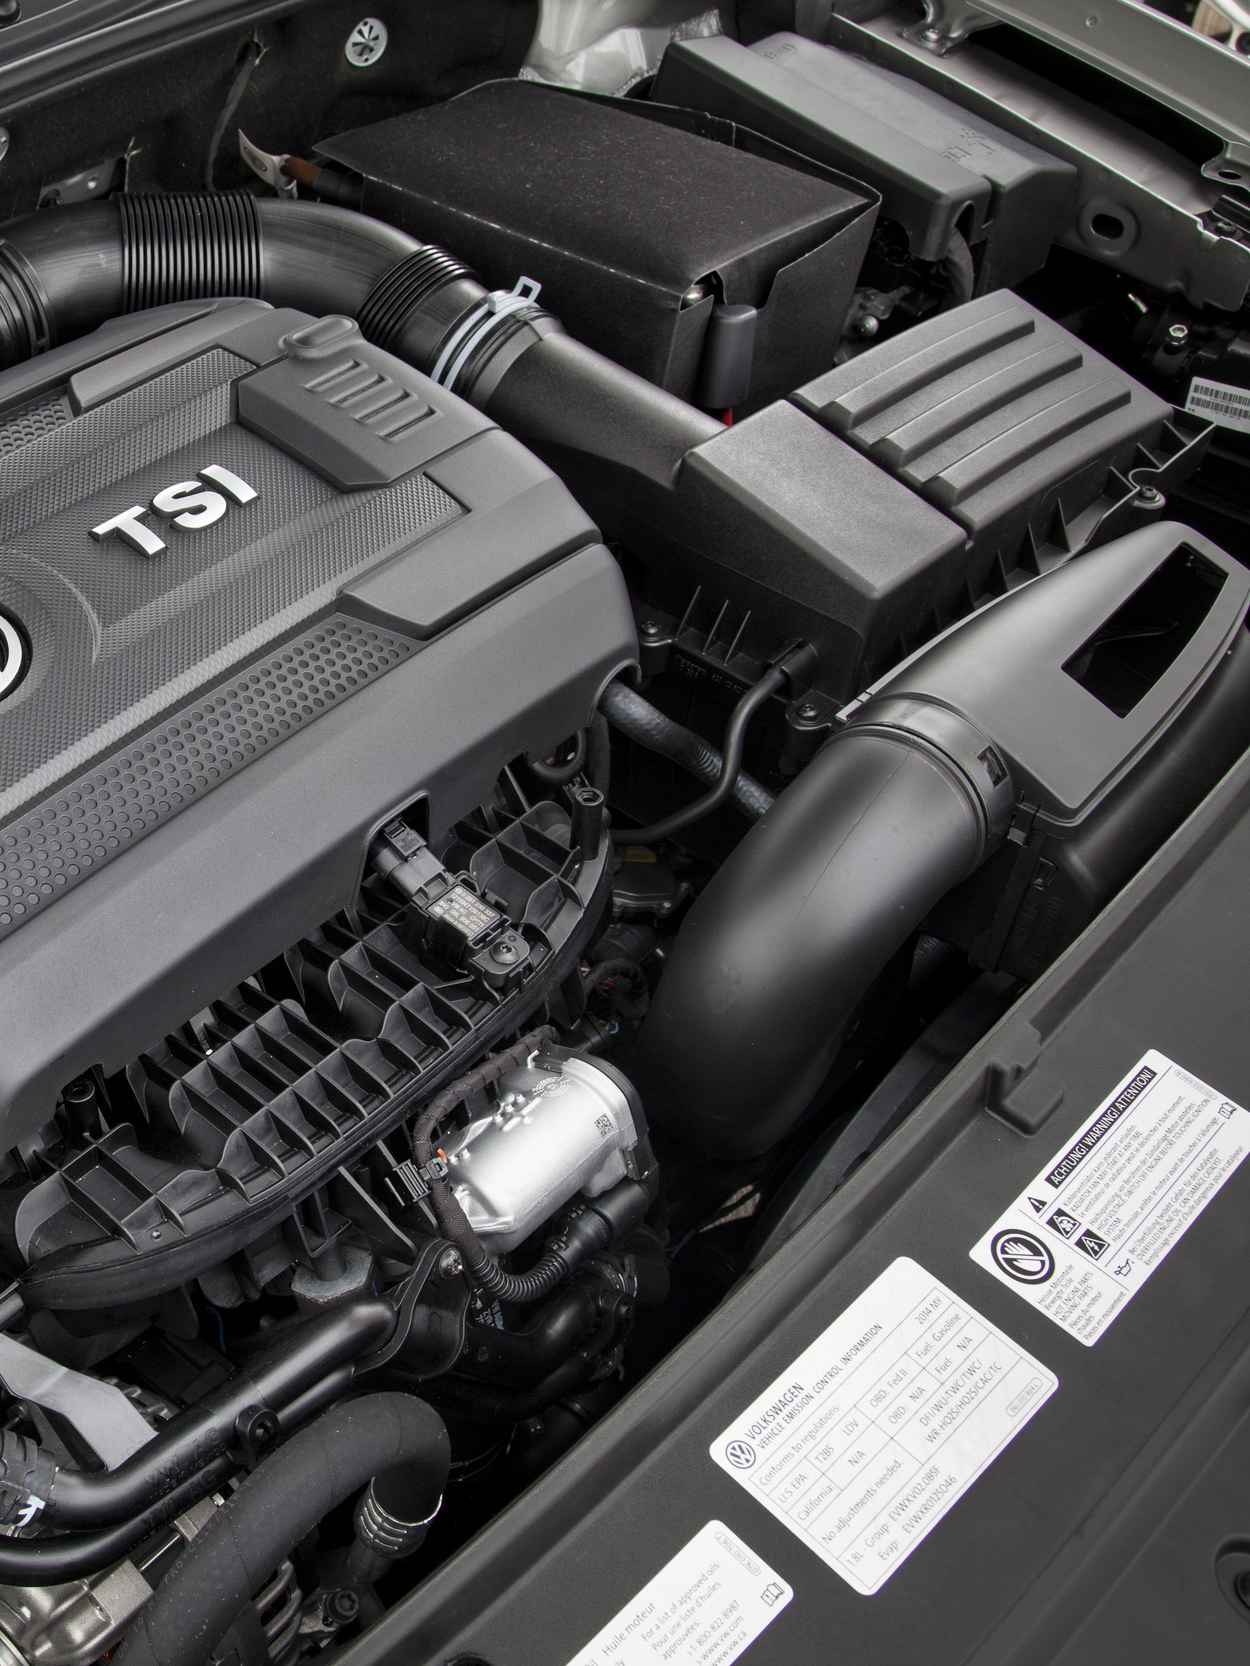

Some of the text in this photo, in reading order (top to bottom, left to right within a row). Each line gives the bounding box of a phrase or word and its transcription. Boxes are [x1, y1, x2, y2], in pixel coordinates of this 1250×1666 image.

[87, 464, 258, 558] TSI
[1048, 1067, 1154, 1185] ACHTUNG! WARNING! ATTENTION!
[1069, 1187, 1093, 1212] RADIATOR
[1088, 1178, 1100, 1190] FAN
[1096, 1168, 1109, 1181] MAY
[1104, 1155, 1120, 1171] START
[1116, 1149, 1125, 1158] AT
[1121, 1140, 1133, 1152] ANY
[1095, 1216, 1110, 1232] HIGH
[1123, 1178, 1142, 1198] SWITCH
[1137, 1170, 1149, 1182] OFF
[1145, 1153, 1162, 1172] ENGINE
[1159, 1137, 1175, 1156] BEFORE
[1172, 1114, 1194, 1141] TOUCHING
[1102, 1215, 1123, 1237] SYSTEM.
[1135, 1231, 1161, 1261] OVERFILLED
[1156, 1213, 1175, 1234] ENGINE
[1178, 1195, 1190, 1208] CAN
[1186, 1175, 1206, 1198] DAMAGE
[1036, 1262, 1074, 1305] Heisse Motorteile
[1051, 1269, 1094, 1317] HOT ENGINE PARTS
[1058, 1284, 1093, 1323] MOVING PARTS
[1060, 1276, 1074, 1289] Teile
[915, 1312, 962, 1359] Fuel: Gasoline
[934, 1334, 974, 1375] Fuel: N/A
[756, 1322, 883, 1450] VEHICLE EMISSION CONTROL INFORMATION
[757, 1295, 944, 1487] Conforms to regulations: 2014 MY
[868, 1372, 904, 1408] OBD: Fed
[887, 1385, 926, 1425] OBD: N/A
[918, 1357, 984, 1427] DFI/WU-TWC/TWC/
[744, 1381, 805, 1441] VOLKSWAGEN
[814, 1418, 860, 1464] T2B5 LDV
[847, 1448, 866, 1467] N/A
[790, 1470, 809, 1490] EPA:
[795, 1481, 835, 1522] California:
[821, 1457, 903, 1545] No adjustments needed.
[846, 1549, 865, 1568] 1.8L
[863, 1519, 894, 1551] Group:
[877, 1537, 902, 1563] Evap:
[640, 1558, 722, 1642] For list of approved oils:
[650, 1578, 722, 1652] Pour une liste d'huiles
[600, 1600, 658, 1656] Huile moteur
[658, 1618, 704, 1662] approuvées:
[697, 1613, 747, 1661] www.vw.com
